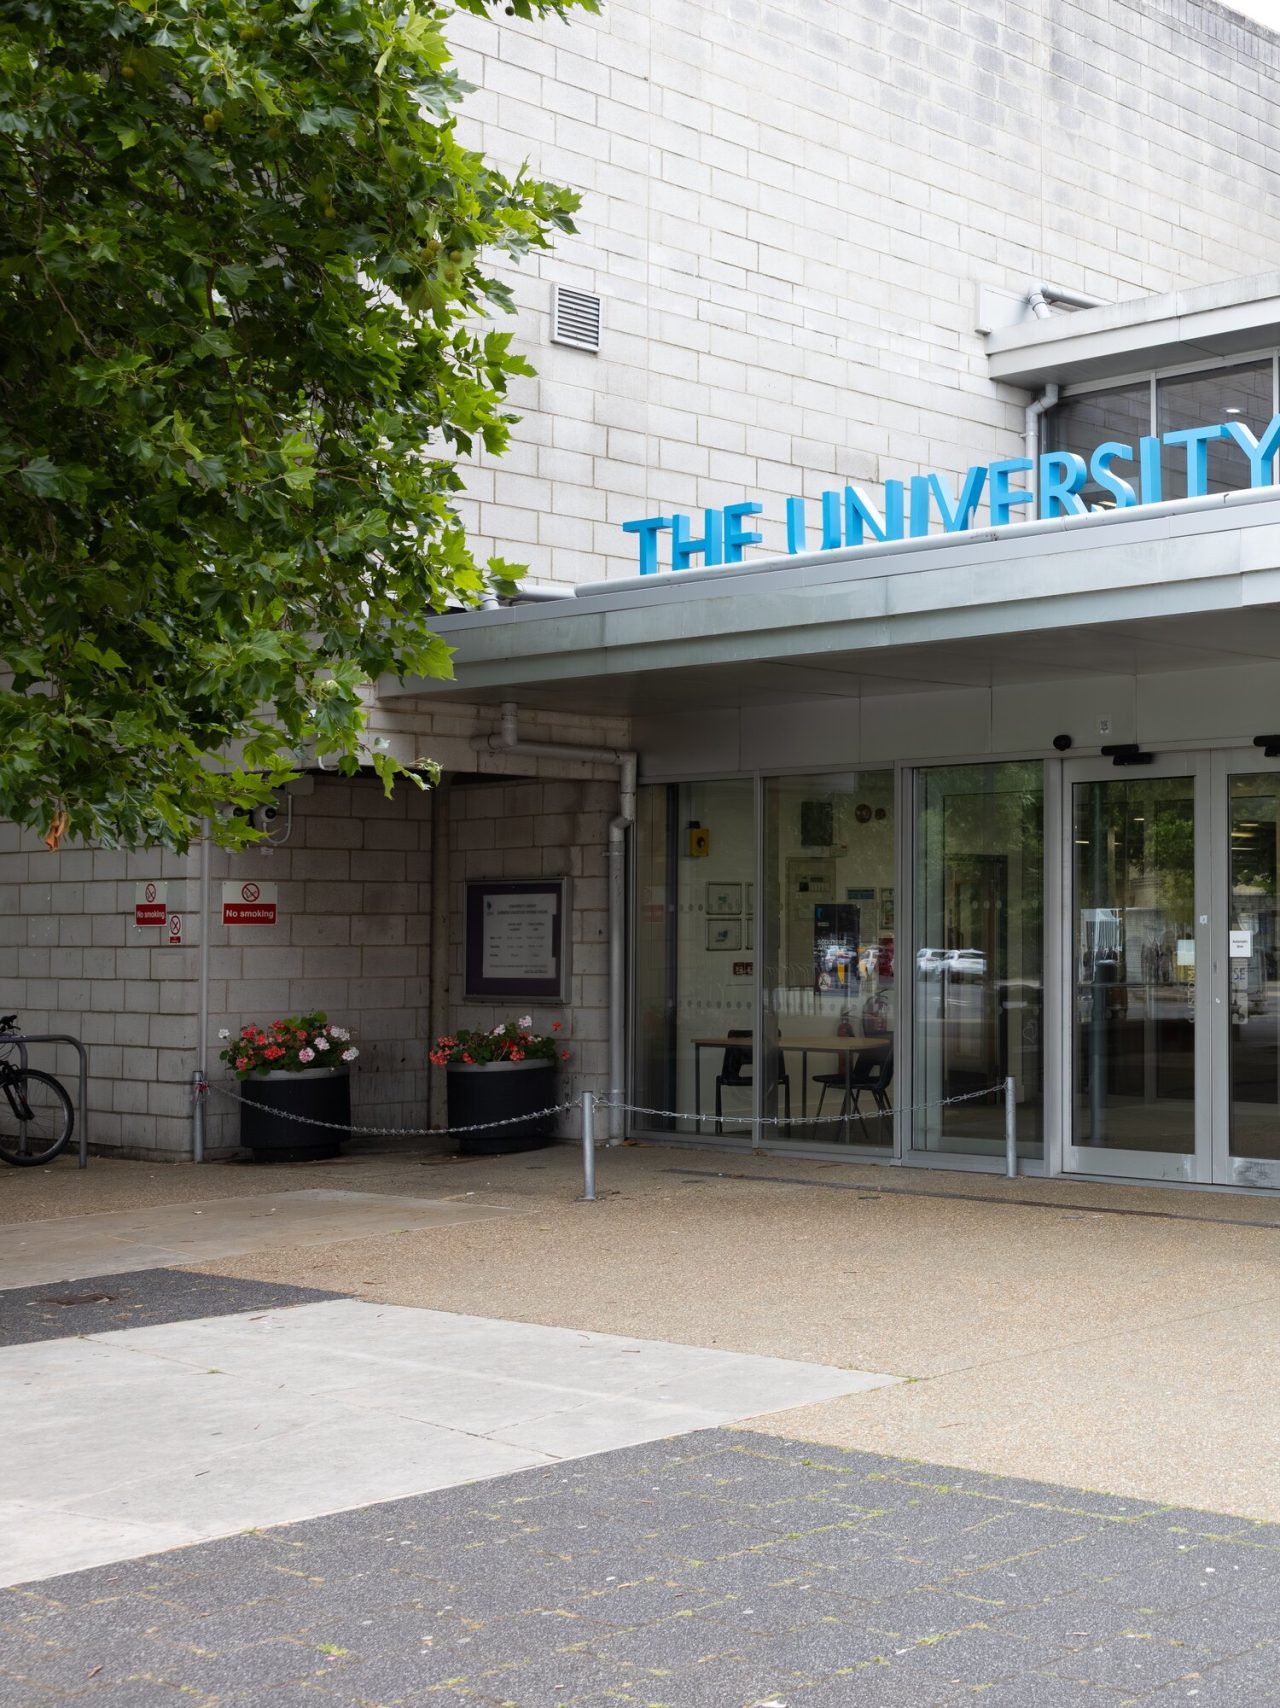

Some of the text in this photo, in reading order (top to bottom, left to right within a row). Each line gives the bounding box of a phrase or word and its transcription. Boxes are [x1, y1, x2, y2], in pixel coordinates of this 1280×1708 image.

[622, 501, 763, 576] THE
[137, 910, 165, 919] No smoking
[225, 910, 274, 918] No smoking
